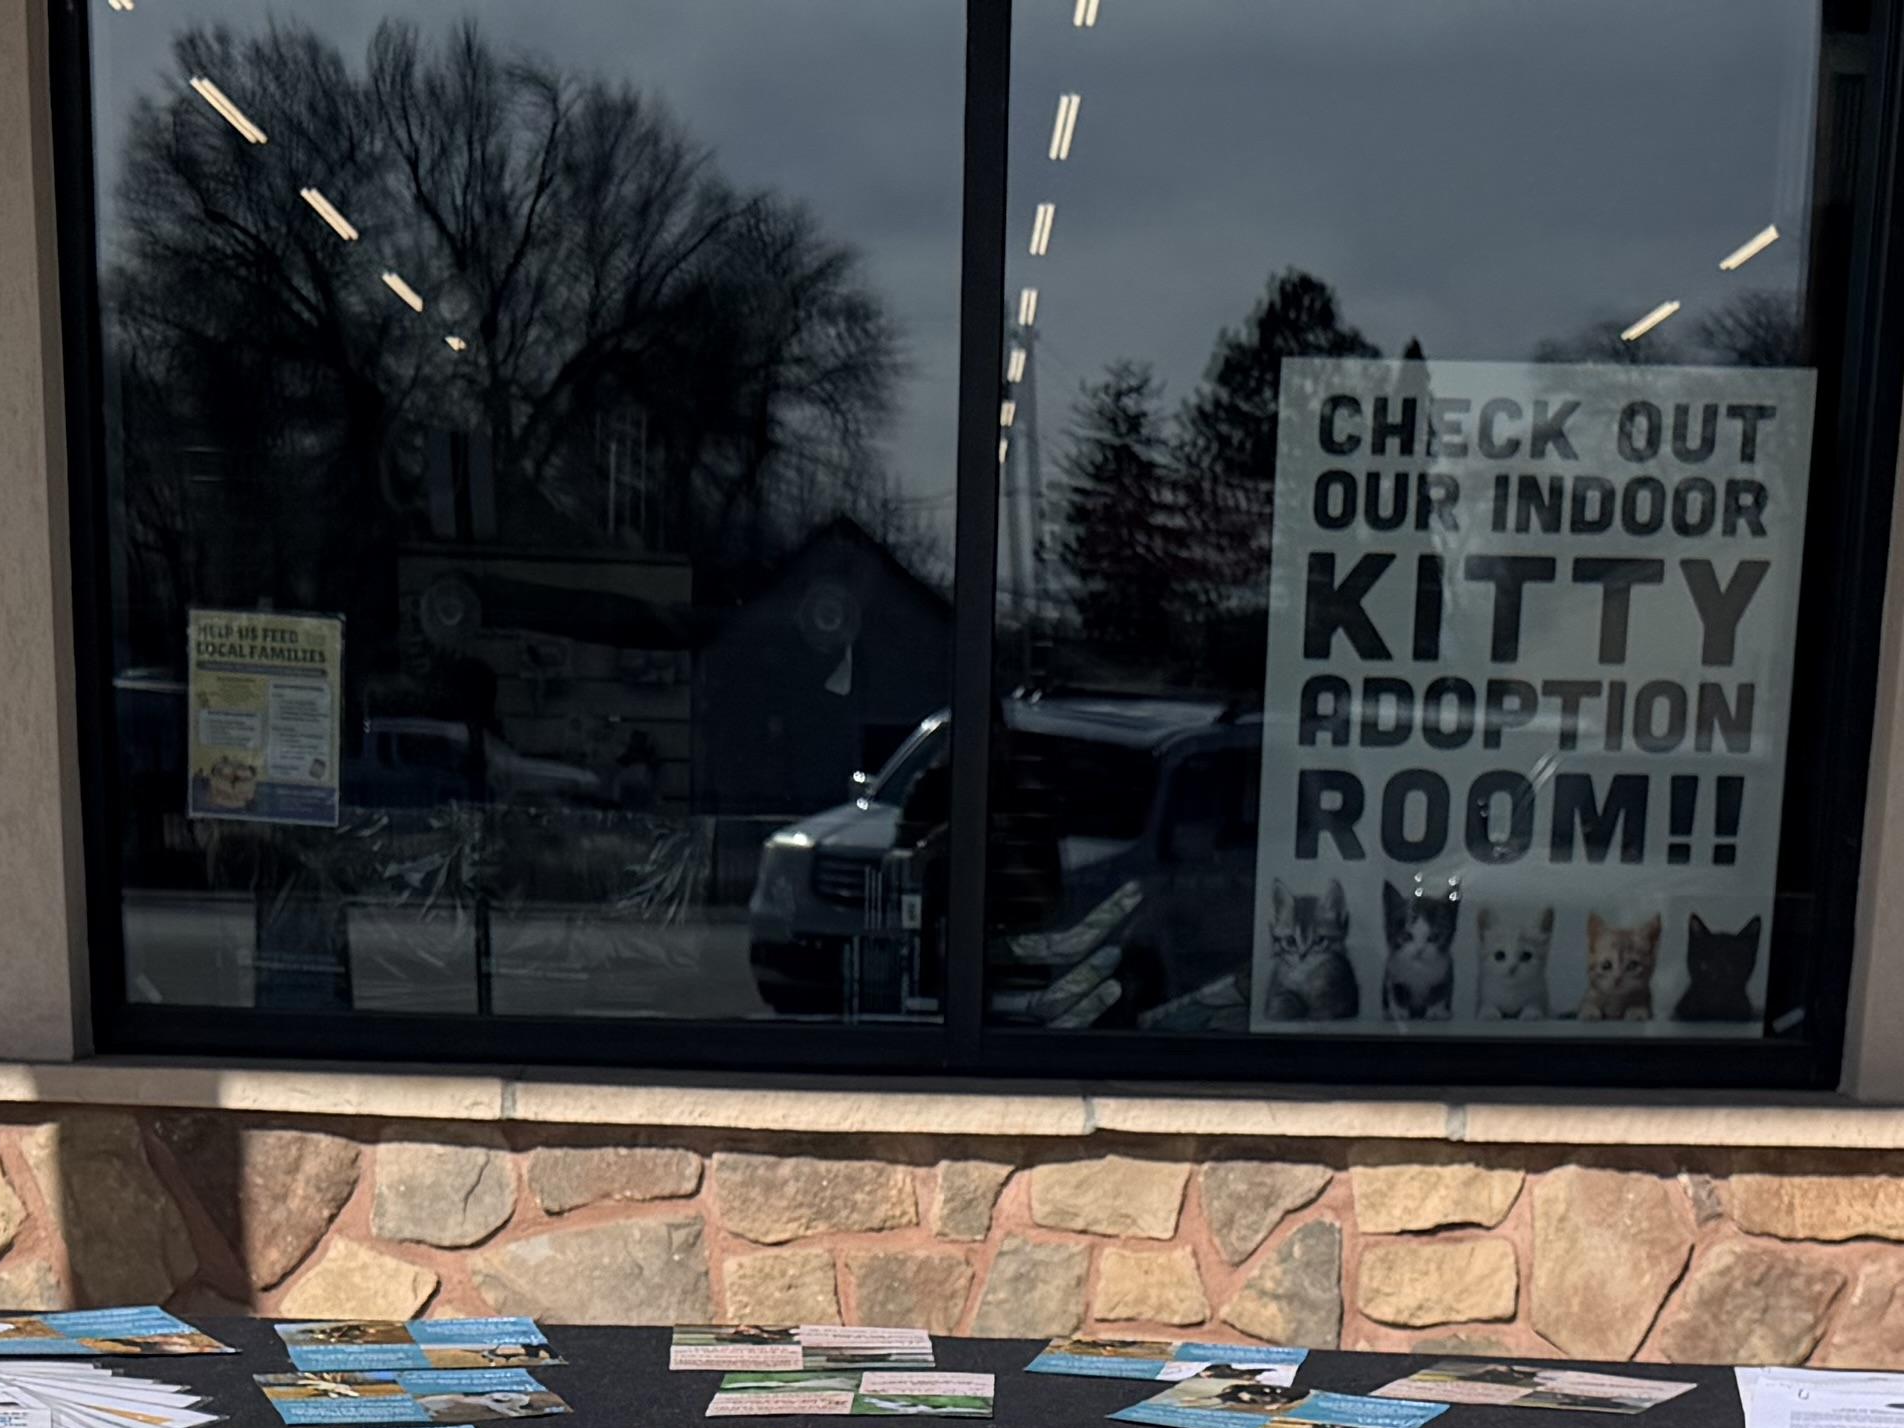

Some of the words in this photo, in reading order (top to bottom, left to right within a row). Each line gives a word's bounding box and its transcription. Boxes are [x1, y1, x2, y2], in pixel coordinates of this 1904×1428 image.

[1318, 393, 1581, 461] CHECK
[1616, 402, 1778, 464] OUT
[1312, 469, 1462, 533] OUR
[1490, 474, 1770, 539] INDOOR
[197, 623, 234, 641] HELP
[237, 625, 259, 641] US
[261, 628, 299, 644] FEED
[1302, 551, 1772, 667] KITTY
[196, 641, 247, 658] LOCAL
[249, 645, 327, 663] FAMILIES
[1297, 673, 1756, 755] ADOPTION
[1294, 767, 1746, 867] ROOM!!
